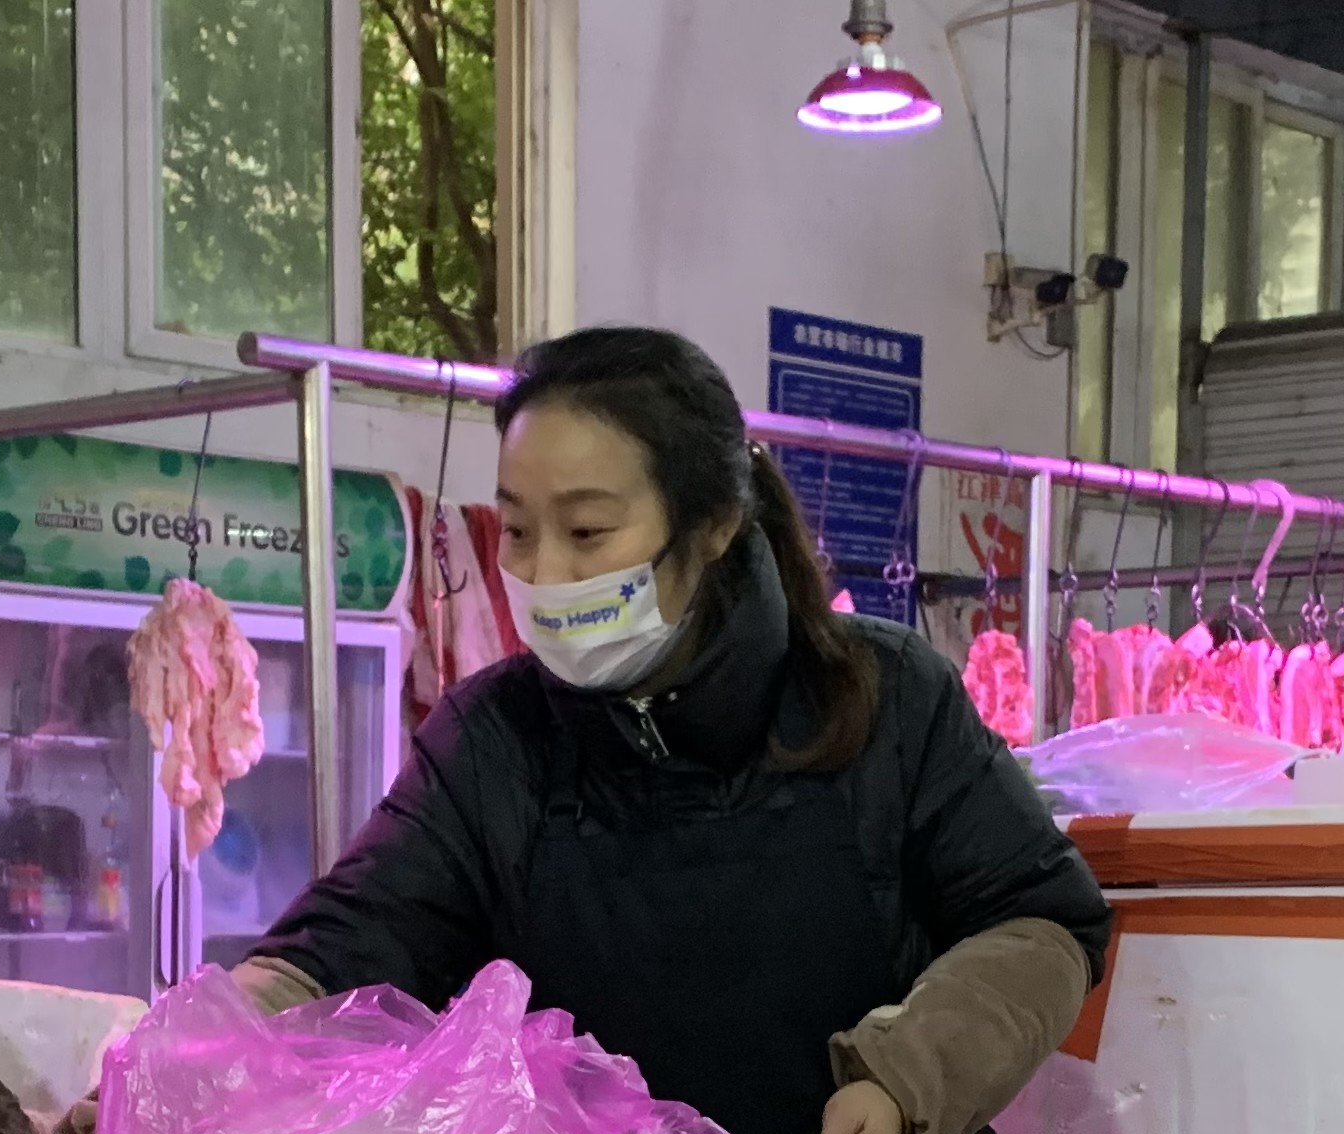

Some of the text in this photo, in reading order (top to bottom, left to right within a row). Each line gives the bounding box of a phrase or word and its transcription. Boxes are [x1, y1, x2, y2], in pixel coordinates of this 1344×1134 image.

[112, 502, 350, 558] Green Freezs
[567, 605, 621, 627] Happy
